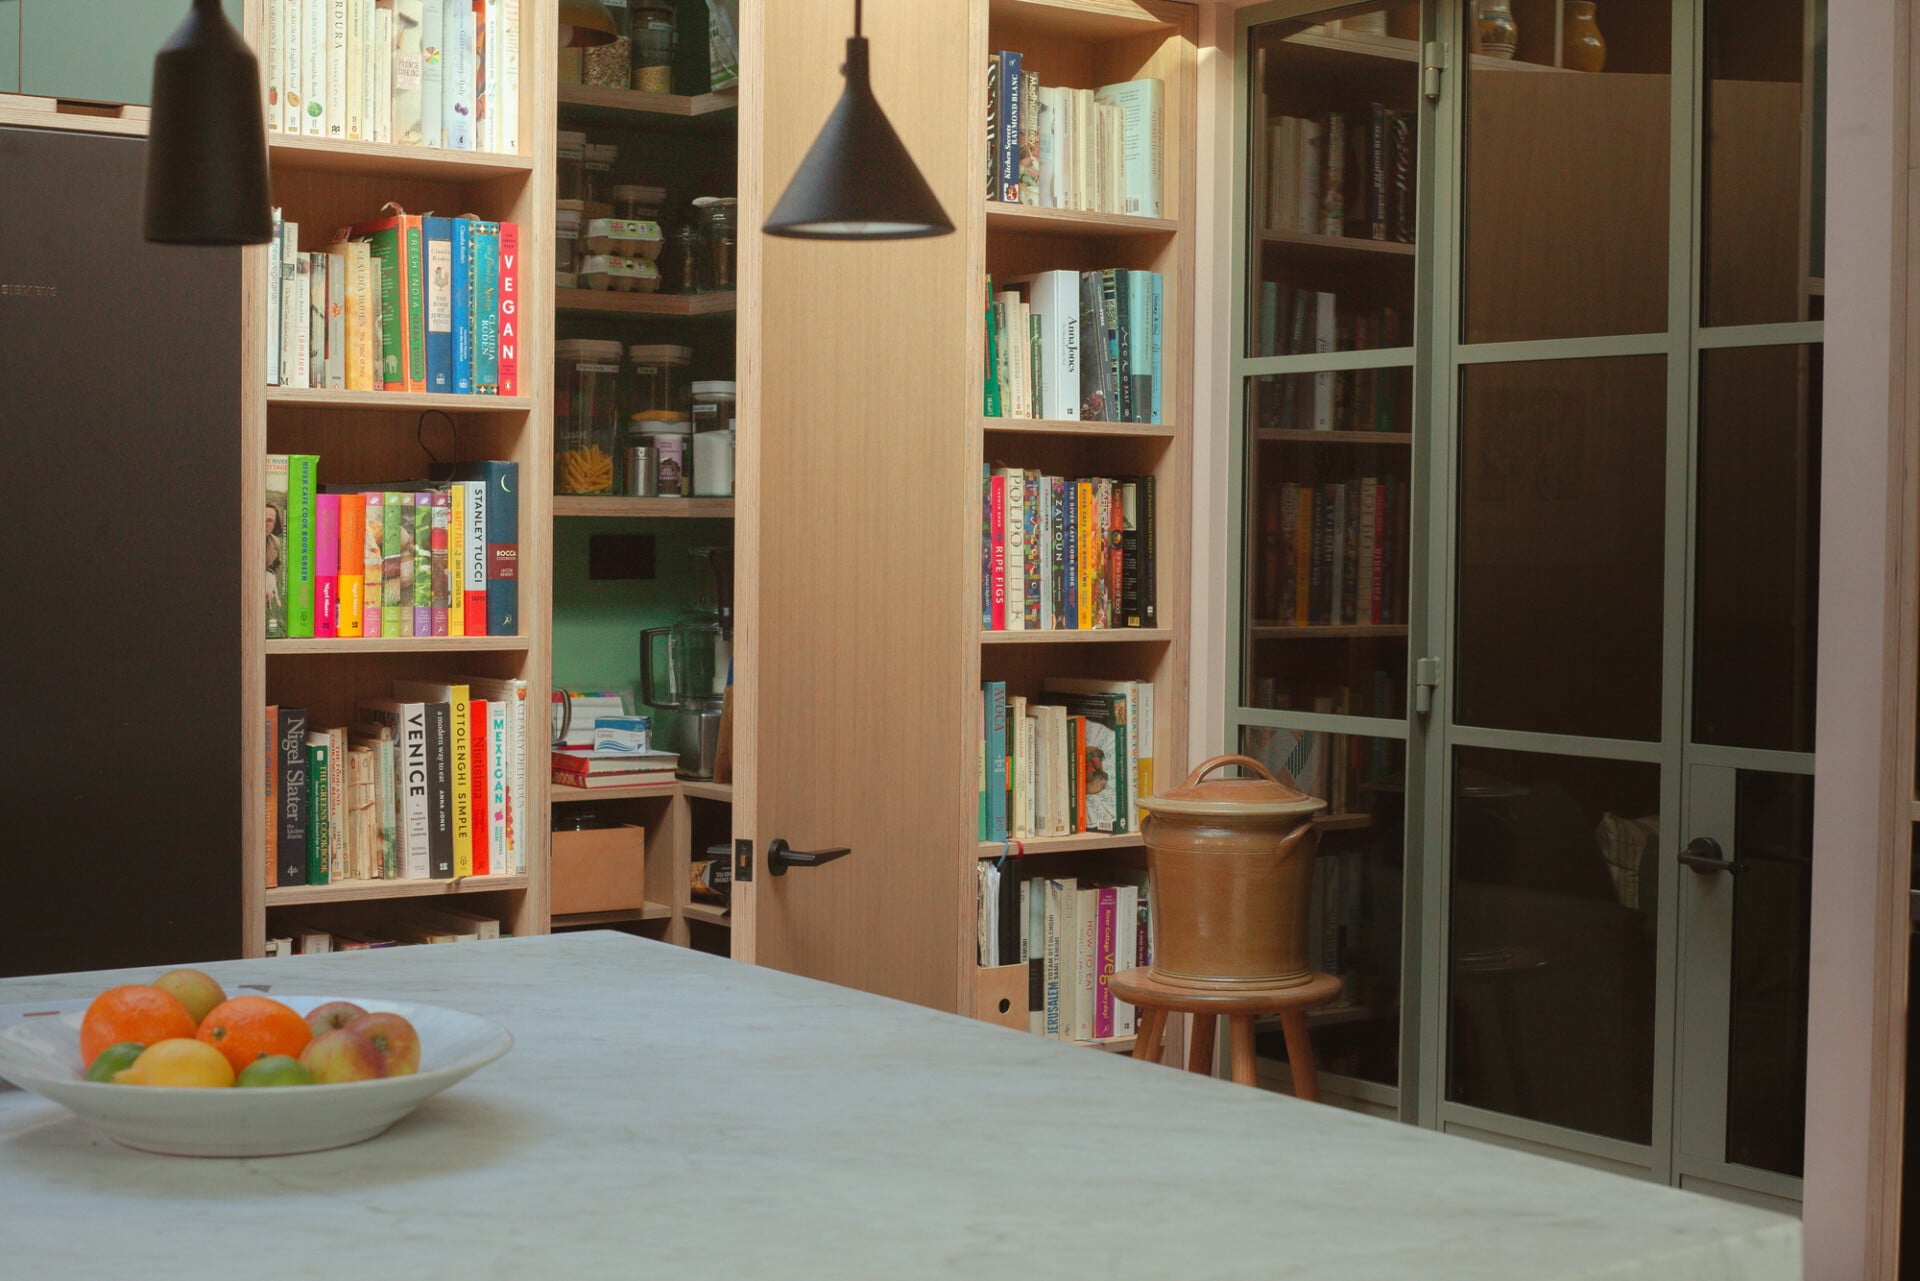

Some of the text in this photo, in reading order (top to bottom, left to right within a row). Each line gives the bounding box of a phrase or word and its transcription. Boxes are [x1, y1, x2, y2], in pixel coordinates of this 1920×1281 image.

[1028, 77, 1037, 146] Madhur Jaffrey
[1004, 151, 1012, 179] Kitchen
[270, 244, 278, 304] new vegetarian
[357, 250, 366, 327] CLAUDIA RODEN
[410, 233, 420, 308] FRESH INDIA
[502, 254, 515, 360] VEGAN
[298, 335, 306, 376] tomatoes
[481, 320, 489, 355] RODEN
[488, 314, 496, 360] CLAUDIA
[1066, 317, 1078, 373] Anna Jones
[474, 488, 484, 583] STANLEY TUCCI
[1010, 474, 1022, 548] POLPO
[996, 578, 1004, 604] FIGS
[437, 716, 445, 745] modern
[517, 704, 525, 750] CLEARLY
[994, 688, 1004, 732] AVOCA
[282, 716, 304, 764] Nigel
[408, 714, 424, 797] VENICE
[439, 762, 445, 770] to
[494, 719, 504, 804] MEXICAN
[456, 702, 467, 838] OTTOLENGHI SIMPLE
[474, 736, 485, 800] Nistisima
[517, 753, 526, 809] DELICIOUS
[286, 770, 304, 822] Slater
[1104, 910, 1112, 926] River
[1086, 954, 1093, 968] TO
[1100, 952, 1114, 986] veg
[1047, 982, 1059, 1034] JERUSALEM
[1102, 988, 1110, 1018] everyday!
